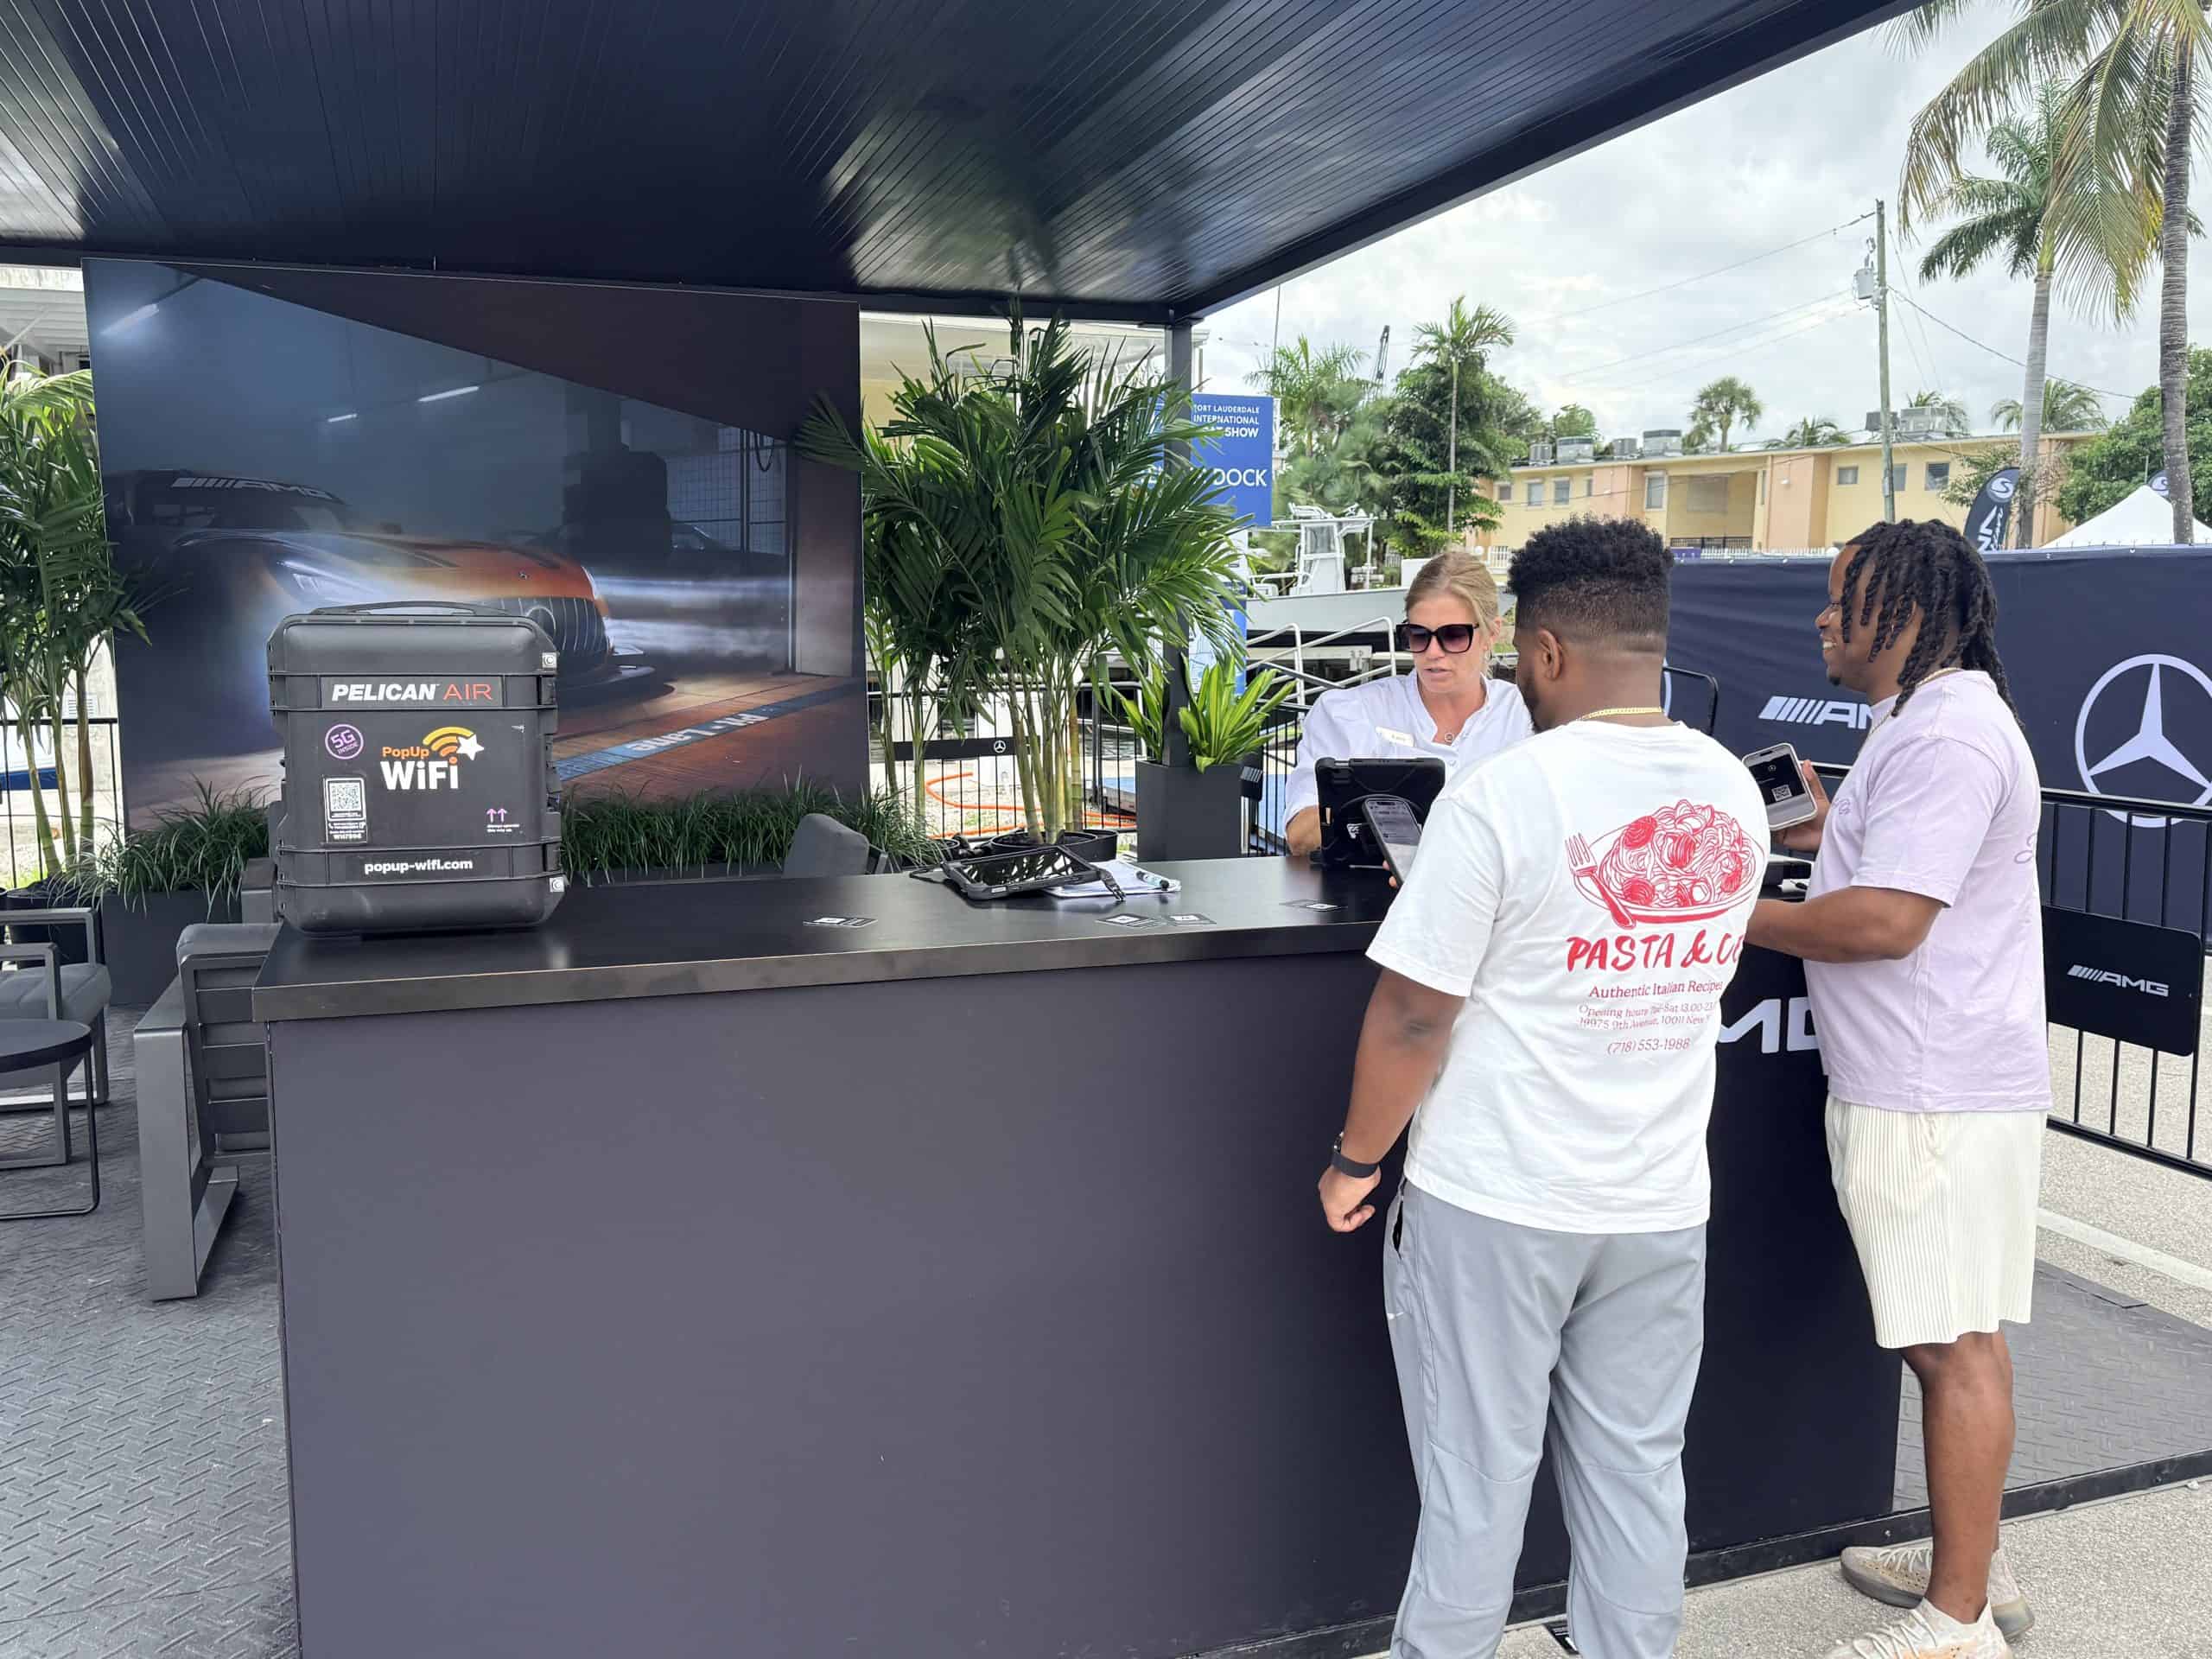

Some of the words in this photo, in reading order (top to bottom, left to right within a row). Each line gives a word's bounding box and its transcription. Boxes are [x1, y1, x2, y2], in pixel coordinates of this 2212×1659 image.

[1213, 405, 1260, 414] LAUDERDALE
[1193, 414, 1260, 425] INTERNATIONAL
[1224, 426, 1260, 438] SHOW
[331, 683, 436, 702] PELICAN
[442, 683, 493, 701] AIR
[330, 729, 356, 748] 5G
[382, 746, 430, 760] PopUp
[380, 756, 459, 790] WiFi
[364, 858, 474, 875] popup-wifi.com
[1565, 931, 1675, 973] PASTA
[1680, 929, 1713, 969] &
[1588, 984, 1651, 999] Authentic
[1653, 981, 1685, 995] Italian
[2098, 970, 2170, 997] AMG
